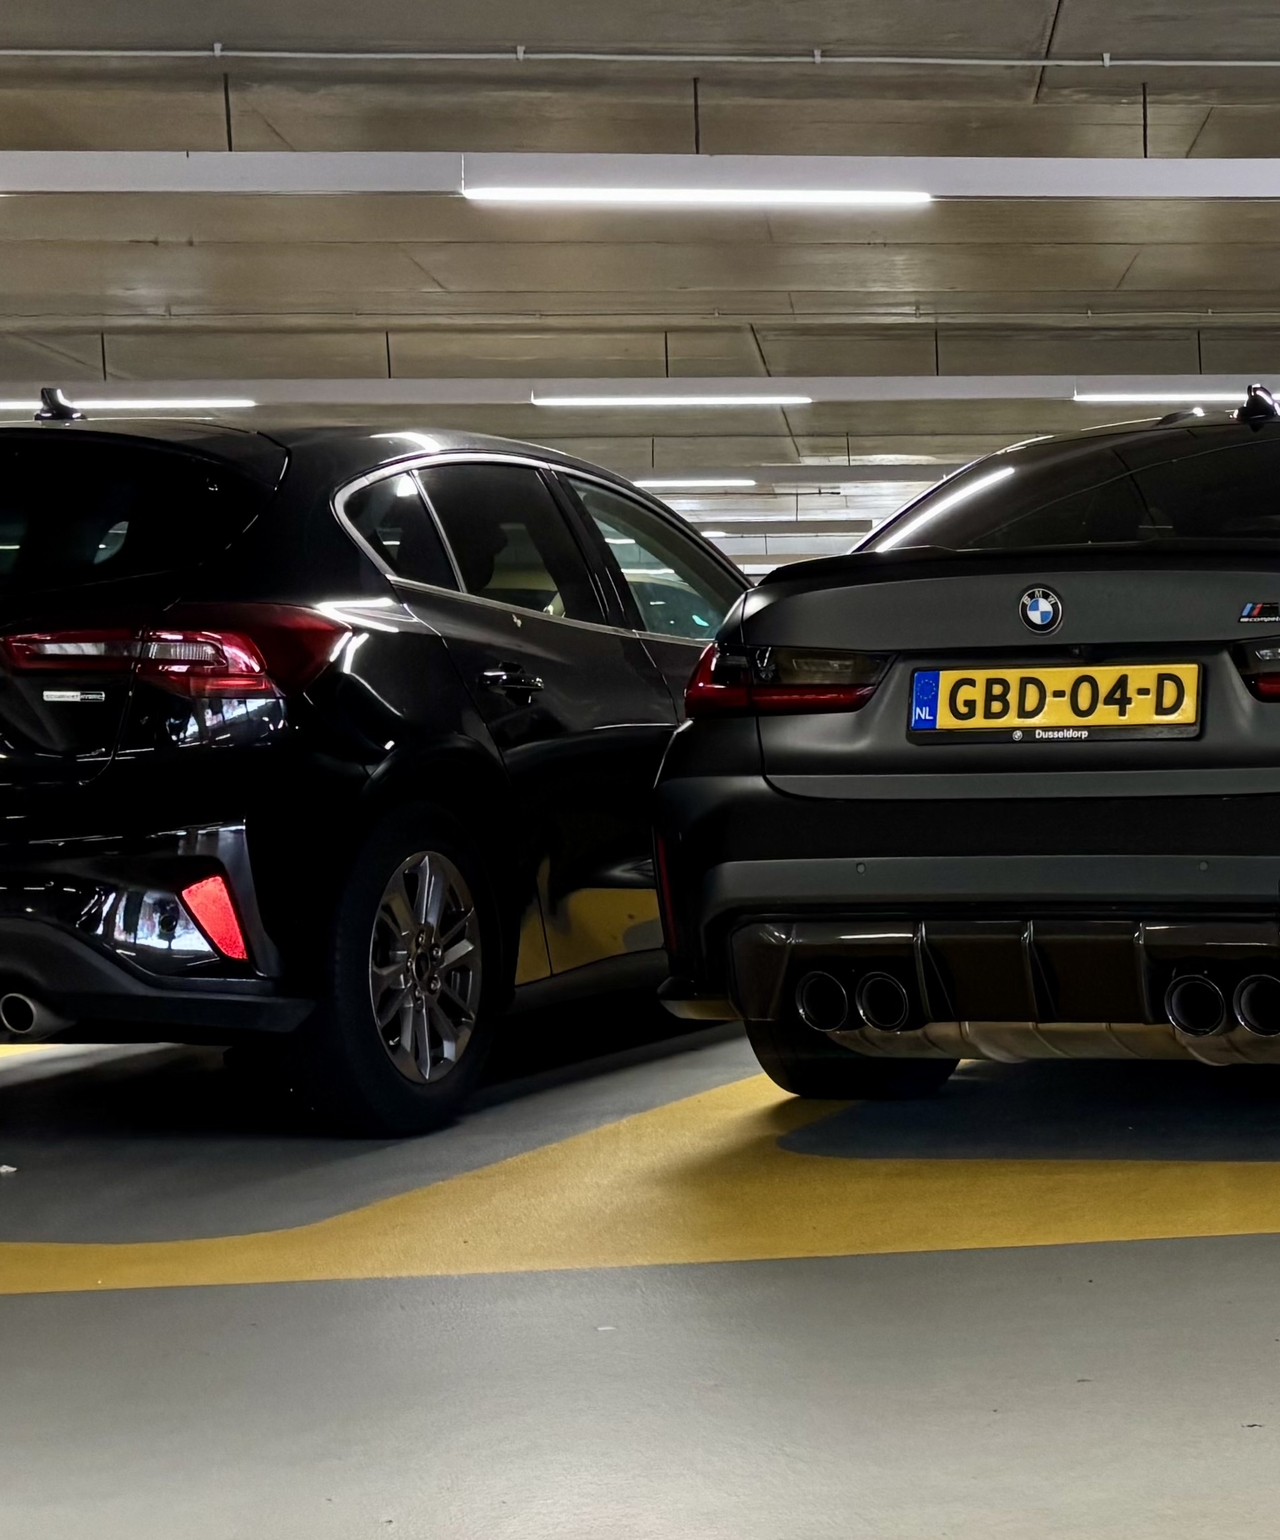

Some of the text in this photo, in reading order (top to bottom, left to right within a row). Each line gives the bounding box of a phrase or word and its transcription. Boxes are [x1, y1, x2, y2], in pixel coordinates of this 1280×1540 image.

[1022, 590, 1057, 605] BMW
[948, 673, 1186, 720] GBD-04-D
[915, 707, 934, 721] NL
[1035, 728, 1089, 740] Dusseldorp
